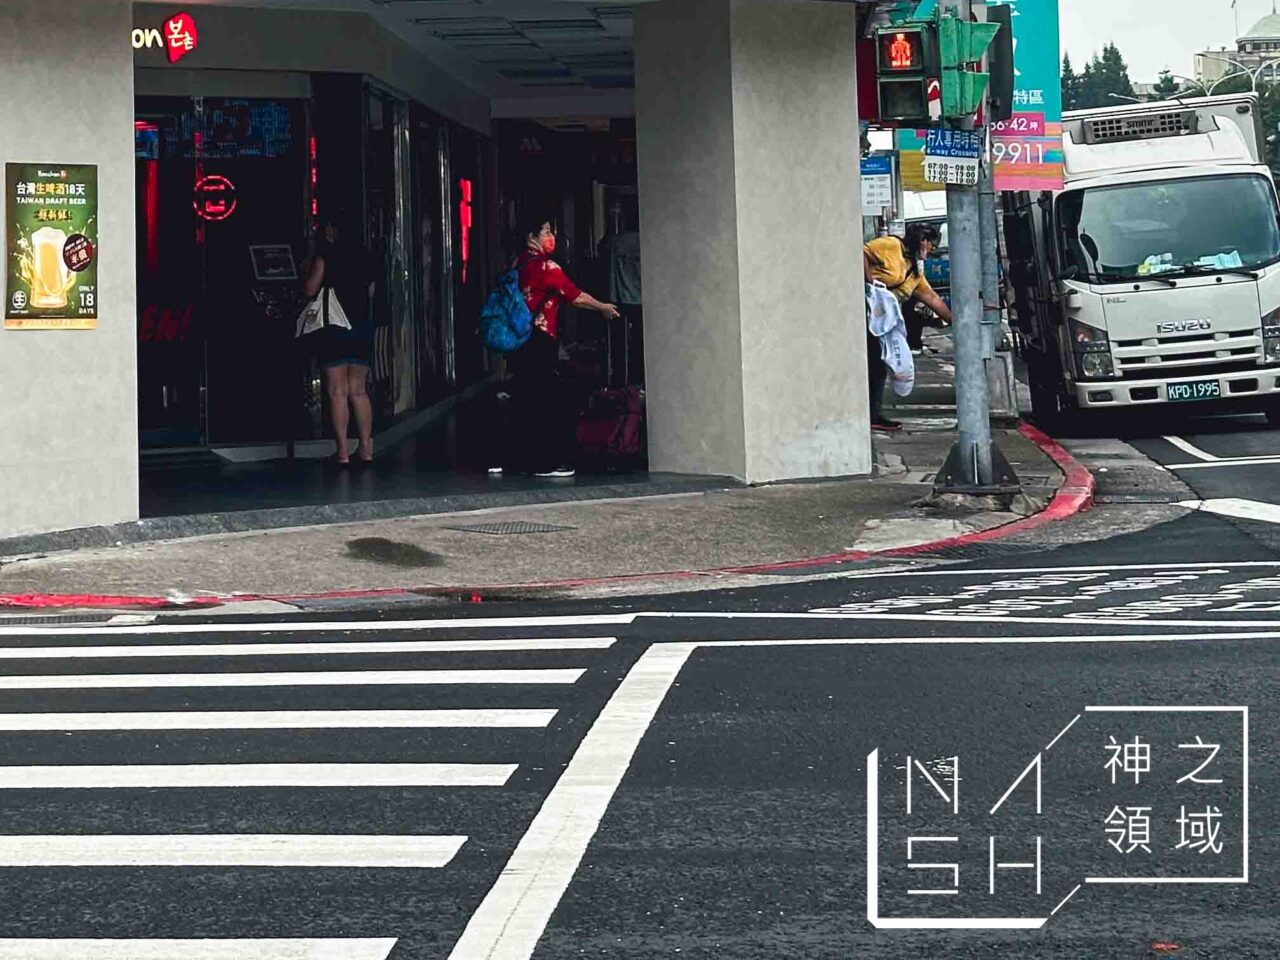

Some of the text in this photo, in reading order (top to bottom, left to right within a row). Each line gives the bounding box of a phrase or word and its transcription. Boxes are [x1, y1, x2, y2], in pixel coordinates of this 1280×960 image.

[79, 293, 94, 306] 18
[1157, 319, 1211, 334] ISUZU
[1168, 382, 1220, 399] KPD-1995
